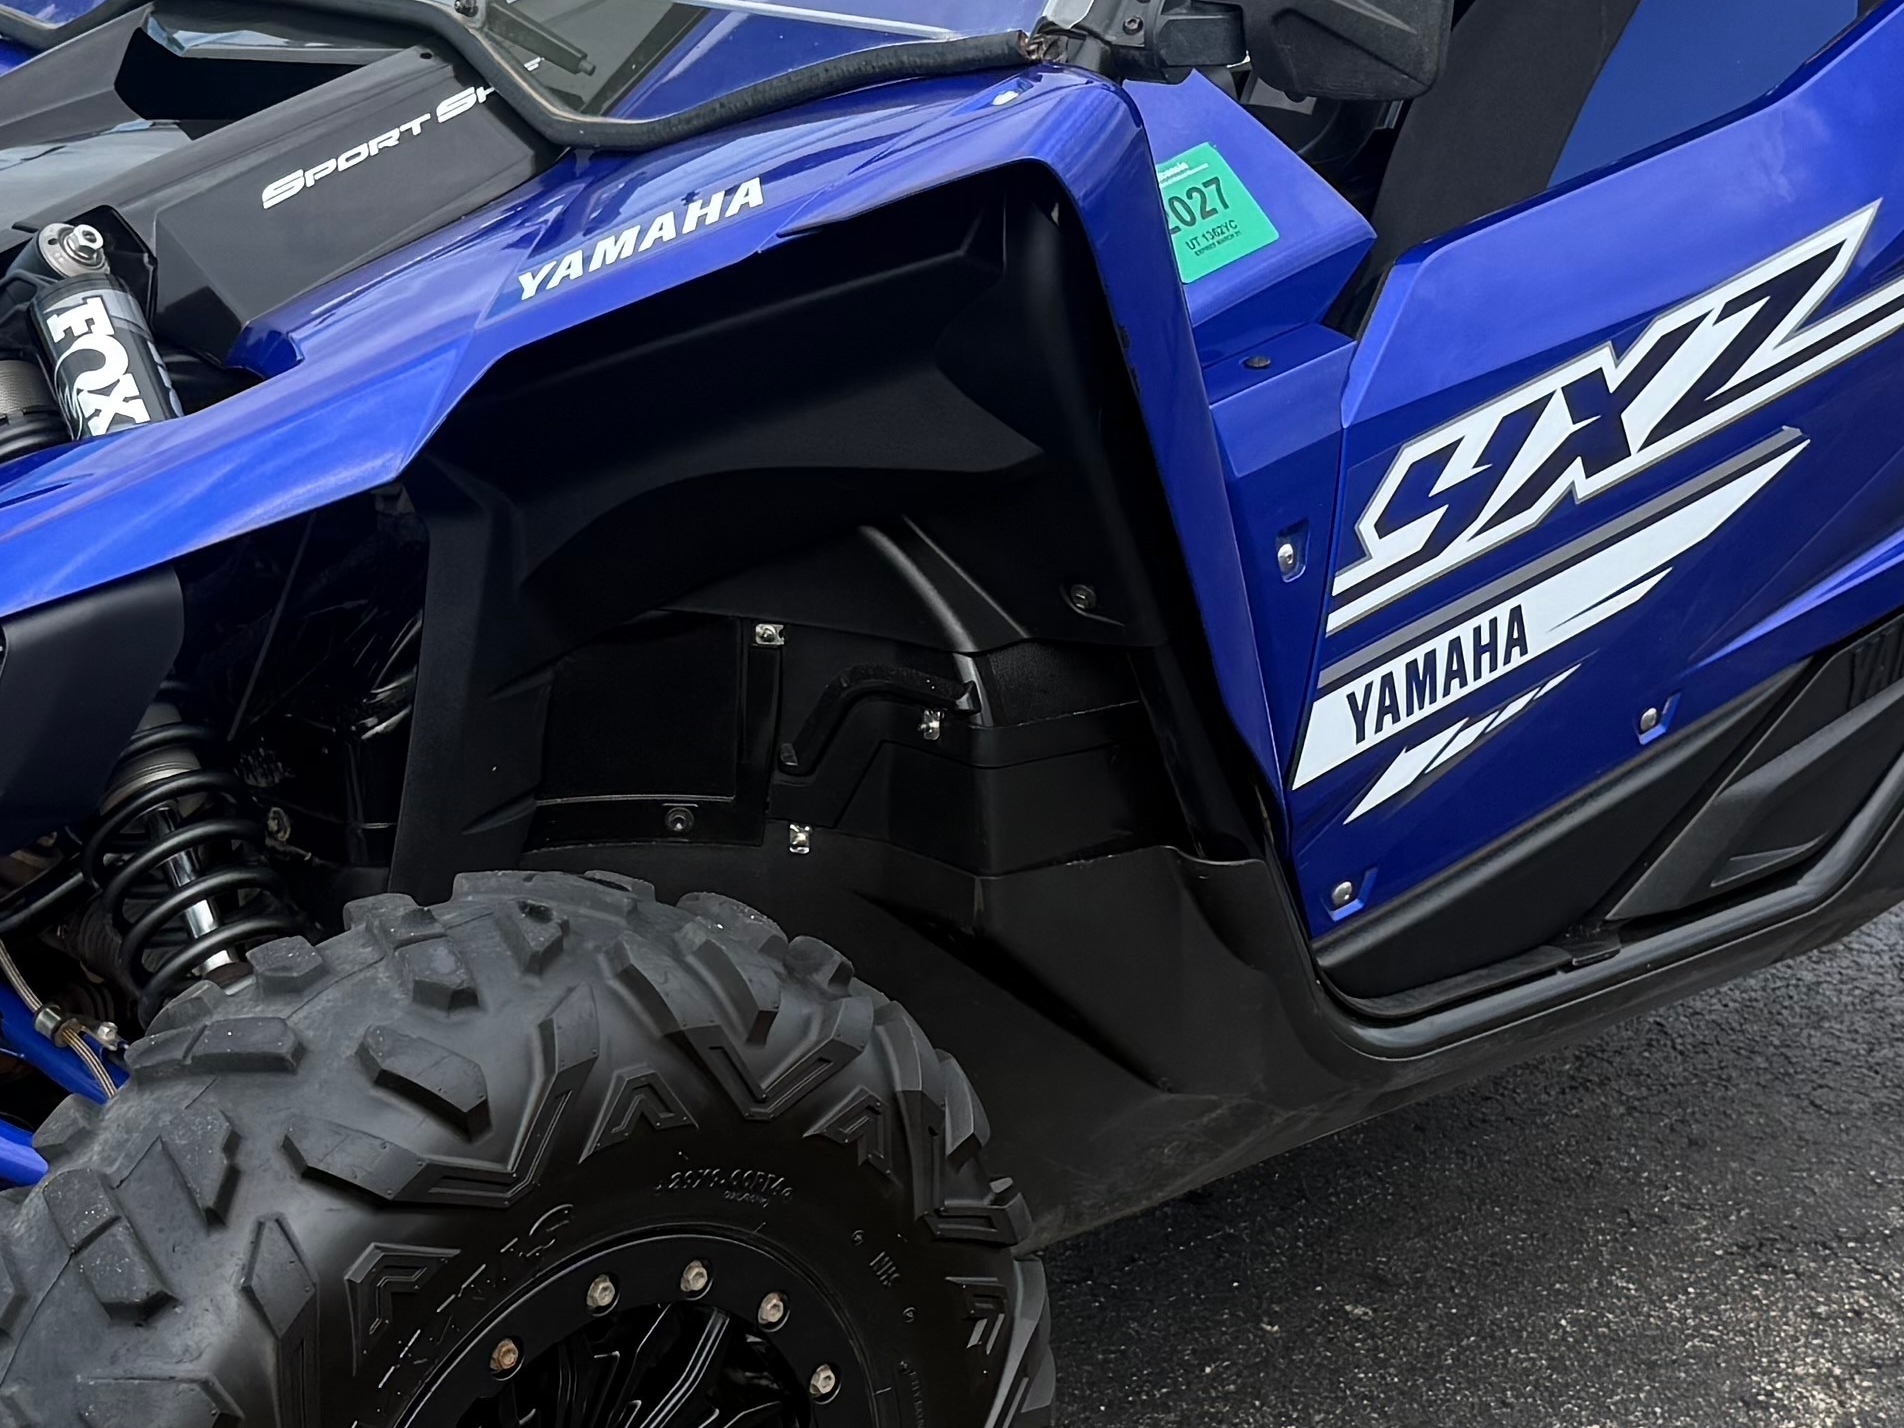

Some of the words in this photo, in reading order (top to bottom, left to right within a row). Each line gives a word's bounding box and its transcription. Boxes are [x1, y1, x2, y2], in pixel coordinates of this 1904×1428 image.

[261, 113, 432, 210] SPORT
[516, 177, 765, 301] YAMAHA
[46, 296, 152, 437] FOX
[1333, 202, 1881, 617] YXZ
[1346, 604, 1529, 746] YAMAHA
